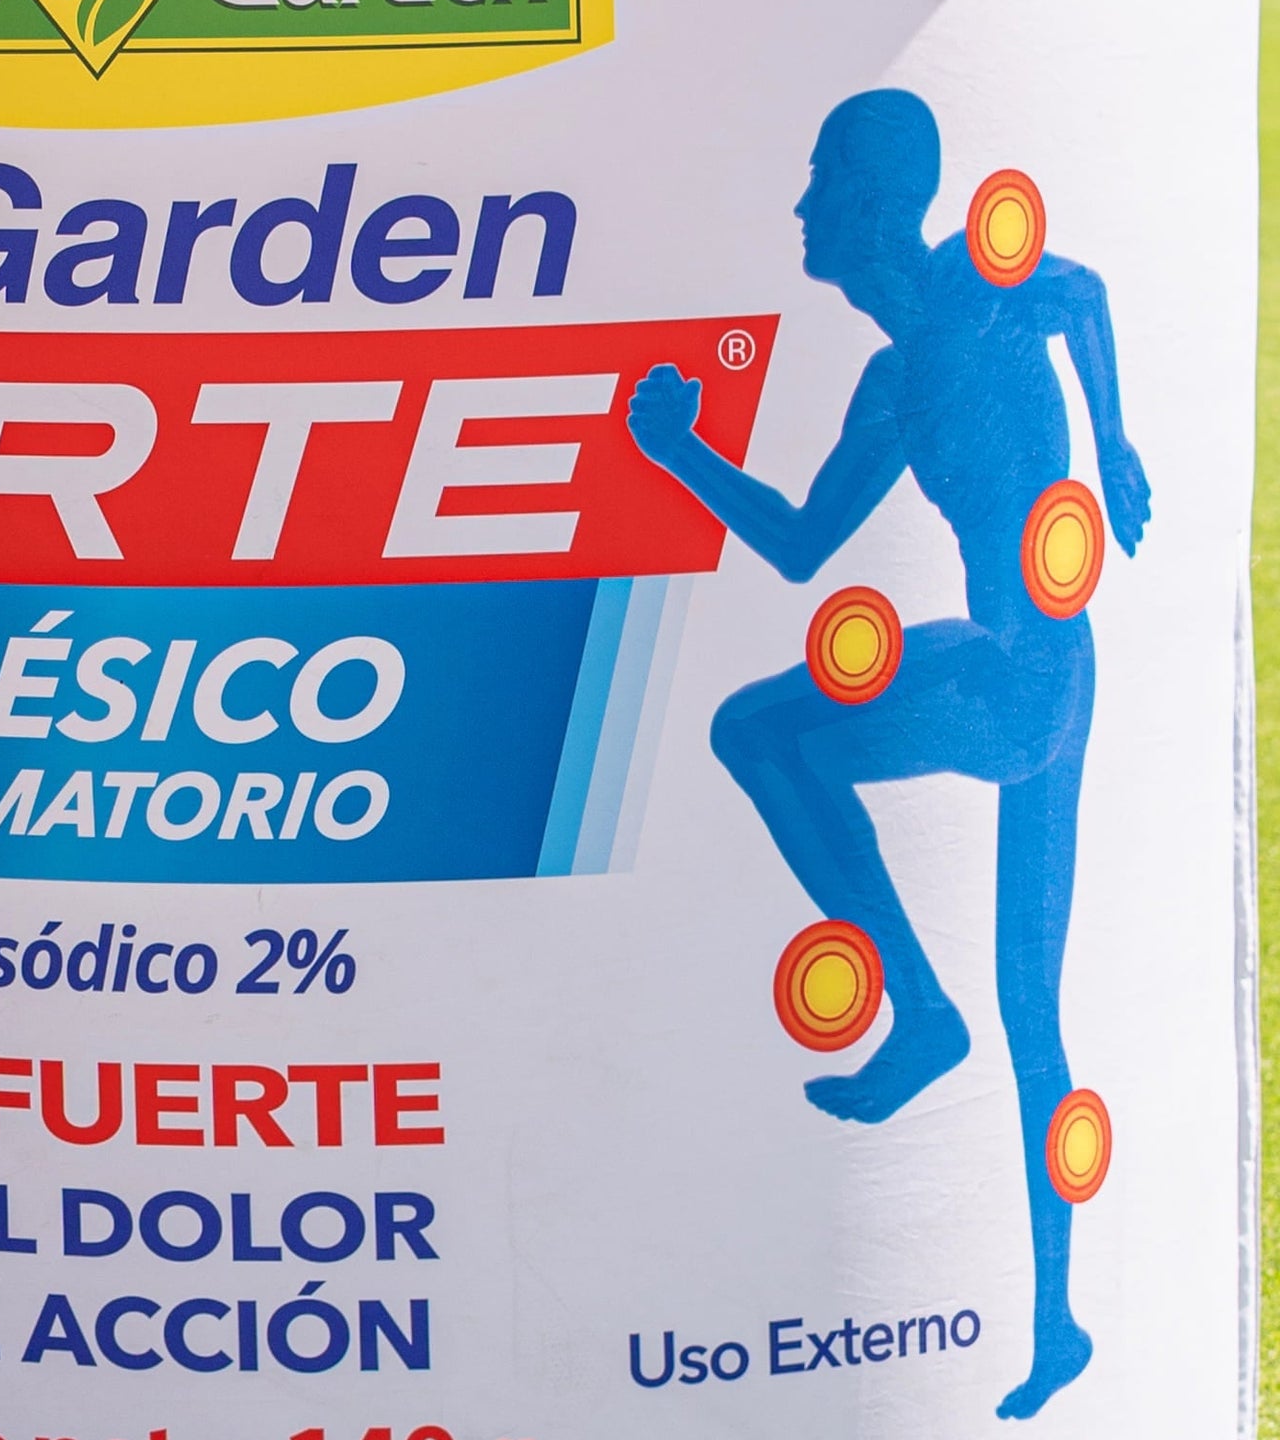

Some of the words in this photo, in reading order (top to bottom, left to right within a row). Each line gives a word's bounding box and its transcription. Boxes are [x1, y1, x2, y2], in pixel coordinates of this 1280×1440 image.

[236, 929, 357, 995] 2%
[61, 1188, 439, 1263] DOLOR
[22, 1281, 432, 1374] ACCIÓN
[629, 1331, 750, 1388] Uso
[769, 1309, 981, 1376] Externo
